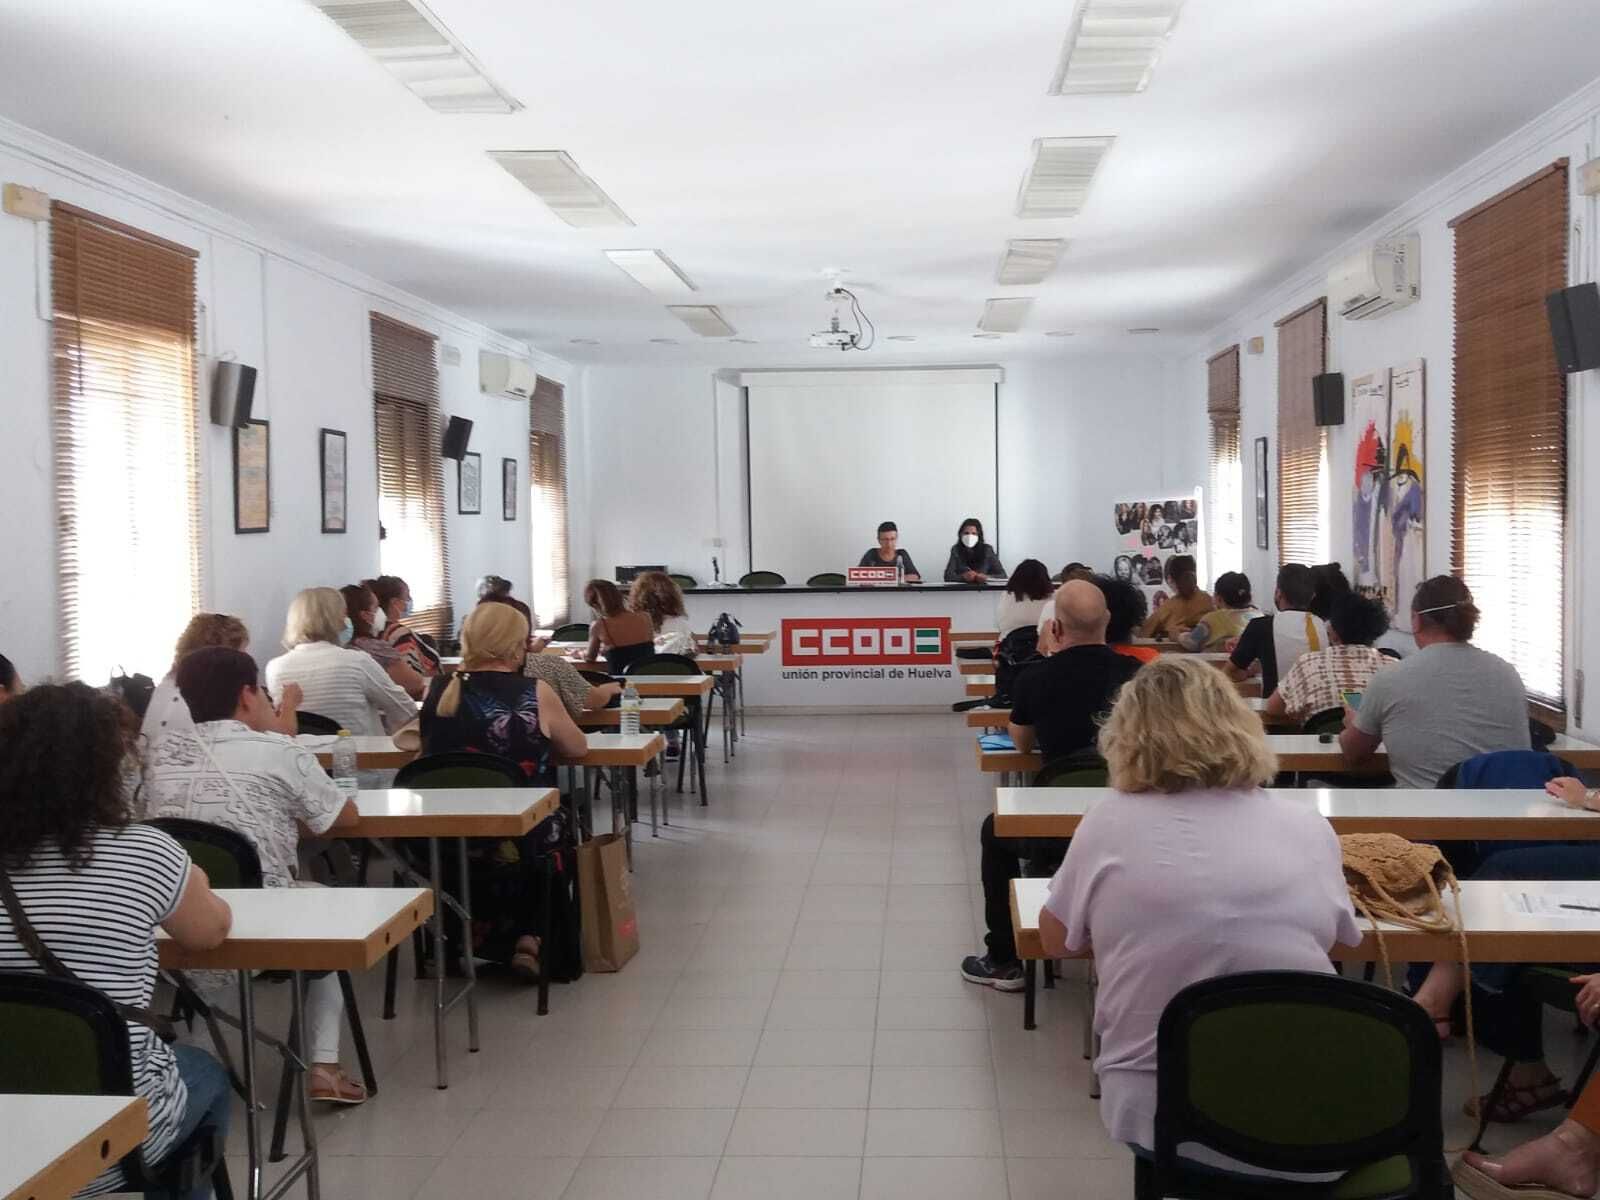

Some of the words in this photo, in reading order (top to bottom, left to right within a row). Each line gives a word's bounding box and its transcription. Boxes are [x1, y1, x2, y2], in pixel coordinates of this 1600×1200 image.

[850, 570, 885, 578] CCOO
[792, 629, 911, 655] CCOO
[782, 669, 818, 679] unión
[822, 669, 885, 681] provincial
[888, 669, 904, 679] de
[908, 669, 952, 679] Huelva
